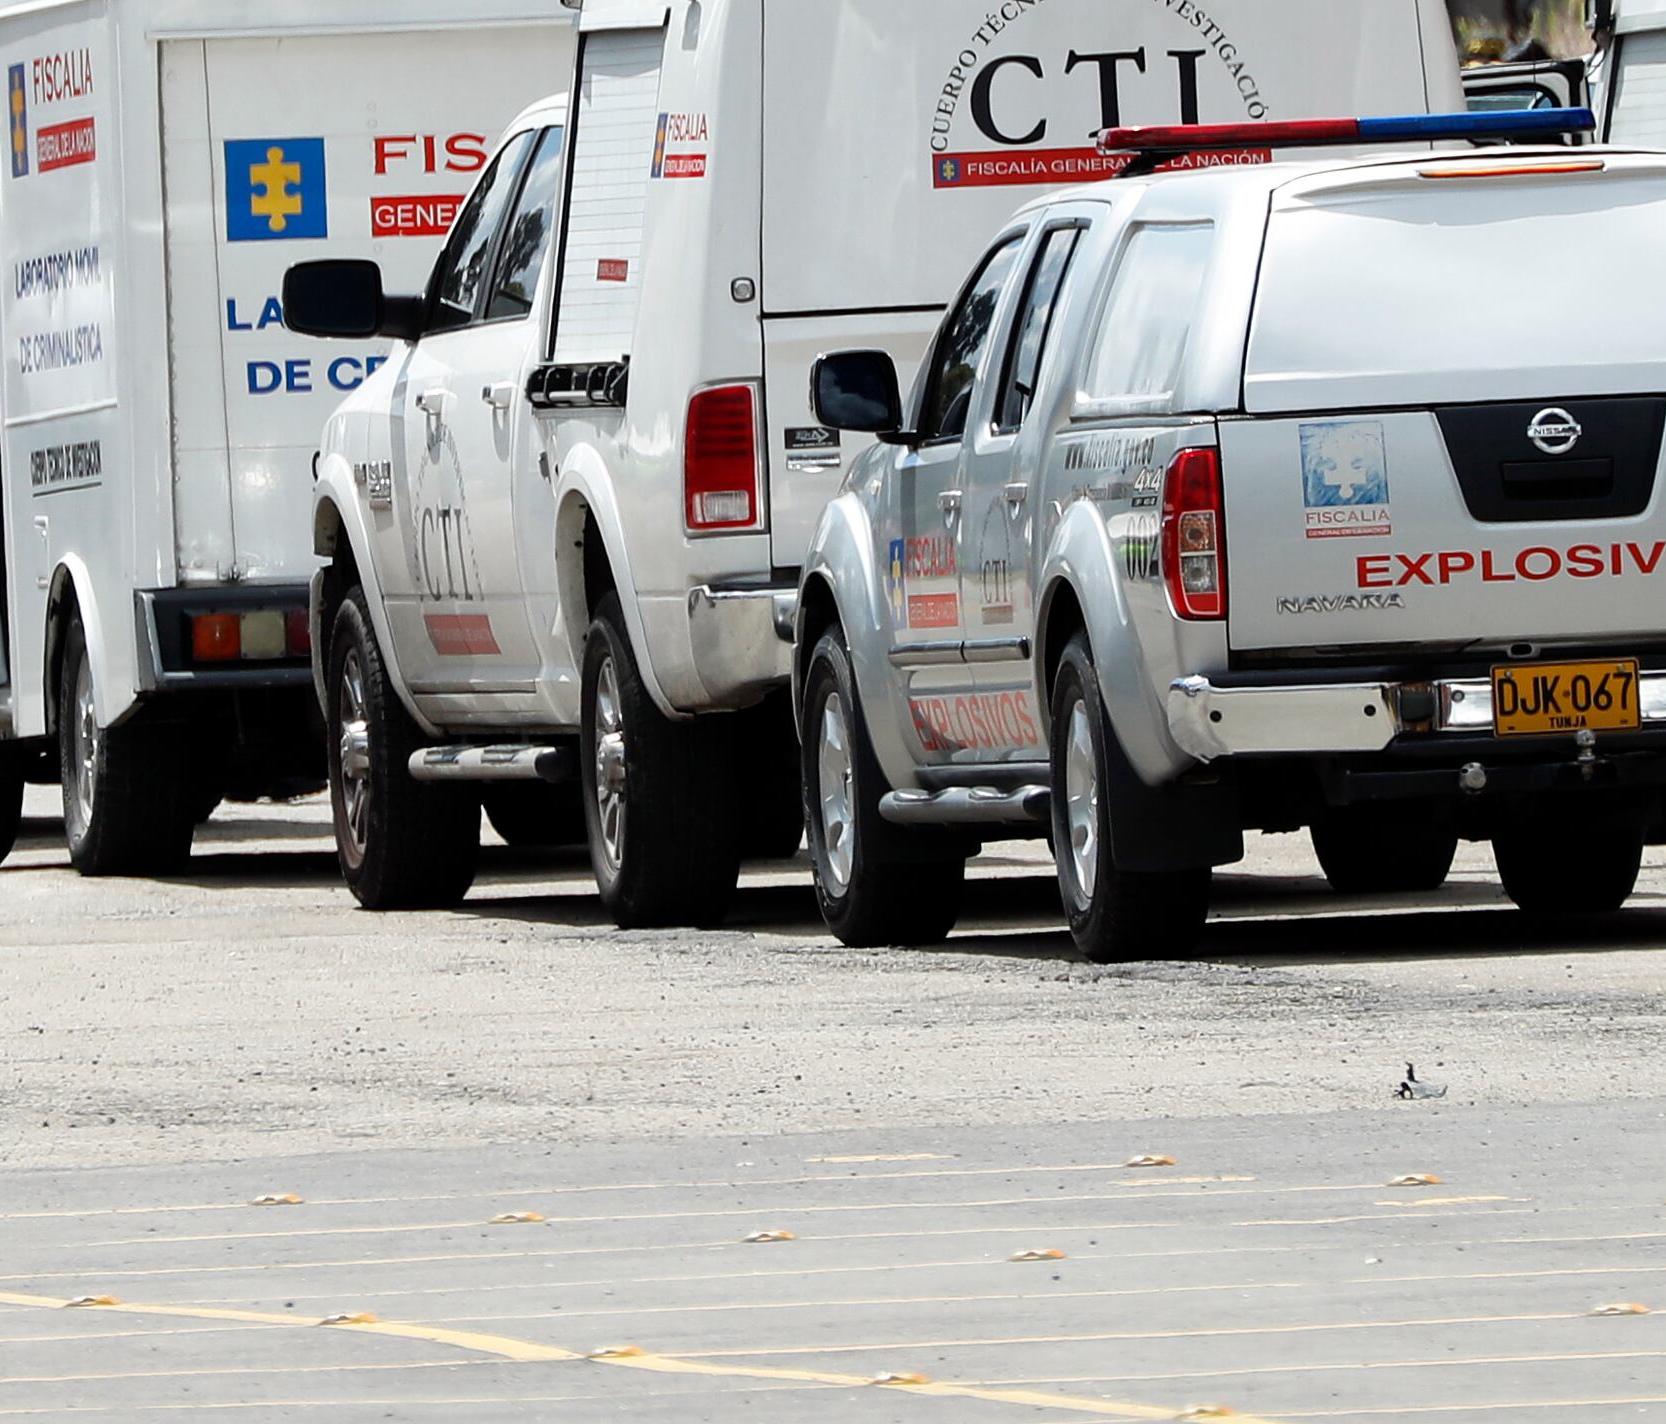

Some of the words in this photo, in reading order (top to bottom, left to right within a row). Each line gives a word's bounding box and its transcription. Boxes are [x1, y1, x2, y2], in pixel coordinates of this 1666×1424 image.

[33, 47, 93, 106] FISCALIA
[969, 46, 1207, 145] CTI
[930, 49, 978, 152] CUERPO
[967, 157, 1047, 176] FISCALÍA
[1051, 155, 1132, 173] GENERA
[1196, 148, 1265, 167] NACIÓN
[375, 203, 461, 229] GENE
[15, 250, 73, 299] LABORATORIO
[20, 336, 32, 374] DE
[33, 322, 102, 372] CRIMINALISTICA
[246, 359, 312, 394] DE
[1306, 508, 1390, 524] FISCALIA
[906, 535, 957, 577] FISCALIA
[983, 559, 1008, 604] CTI
[1276, 591, 1406, 615] NAVARA
[908, 691, 1038, 751] EXPLOSIVOS
[1548, 715, 1588, 729] TUNJA
